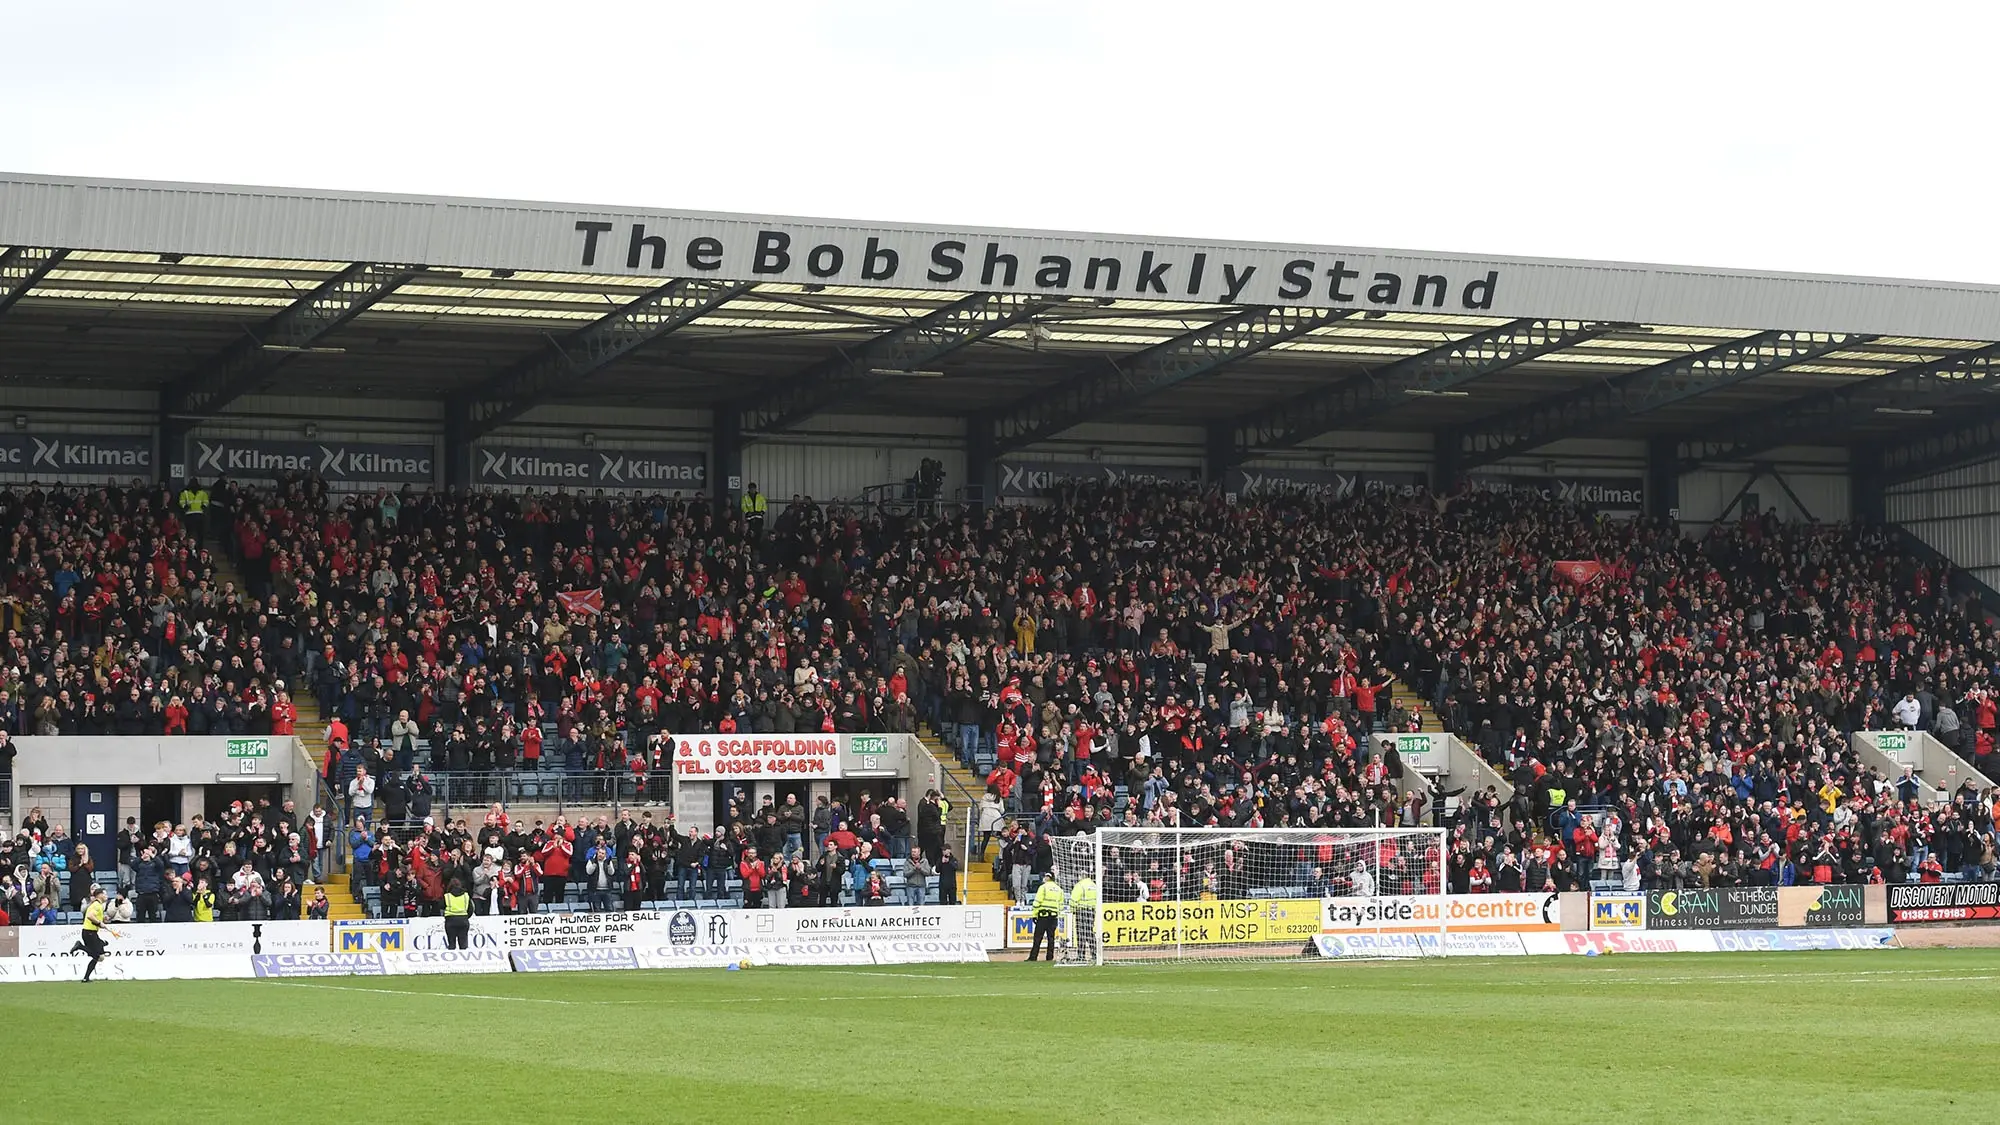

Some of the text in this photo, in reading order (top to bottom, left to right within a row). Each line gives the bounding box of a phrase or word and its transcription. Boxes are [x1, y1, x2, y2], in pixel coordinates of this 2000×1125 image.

[575, 221, 1498, 309] The Bob Shankly Stand
[64, 445, 149, 466] Kilmac
[228, 449, 430, 473] Kilmac Kilmac
[172, 466, 183, 477] 14
[511, 456, 704, 480] Kilmac Kilmac
[729, 478, 740, 488] 15
[1581, 485, 1641, 503] Kilmac
[679, 740, 836, 756] & G SCAFFOLDING
[241, 760, 253, 772] 14
[675, 759, 825, 774] TEL. 01382 454674
[865, 757, 876, 768] 15
[1820, 888, 1861, 909] RAN
[1891, 885, 1955, 908] DISCOVERY
[1103, 902, 1259, 922] ona Robson MSP
[1597, 903, 1639, 919] MKM
[1739, 903, 1776, 915] DUNDEE
[1901, 908, 1966, 920] 01382 679183
[509, 912, 660, 926] HOLIDAY HOMES FOR SALE
[1651, 916, 1720, 927] fitness food
[1808, 911, 1862, 922] ness food
[509, 923, 635, 936] 5 STAR HOLIDAY PARK
[796, 916, 941, 931] JON FRULLANI ARCHITECT
[1286, 924, 1318, 934] 623200
[1220, 923, 1259, 940] MSP
[1451, 933, 1506, 942] Telephone
[343, 931, 400, 951] MKM
[413, 933, 498, 950] CLAON
[509, 935, 617, 947] ST ANDREWS, FIFE
[893, 942, 981, 953] CROWN
[534, 949, 630, 961] CROWN
[656, 944, 750, 957] CROWN
[774, 943, 865, 955] CROWN
[277, 953, 380, 966] CROWN
[406, 951, 504, 962] CROWN
